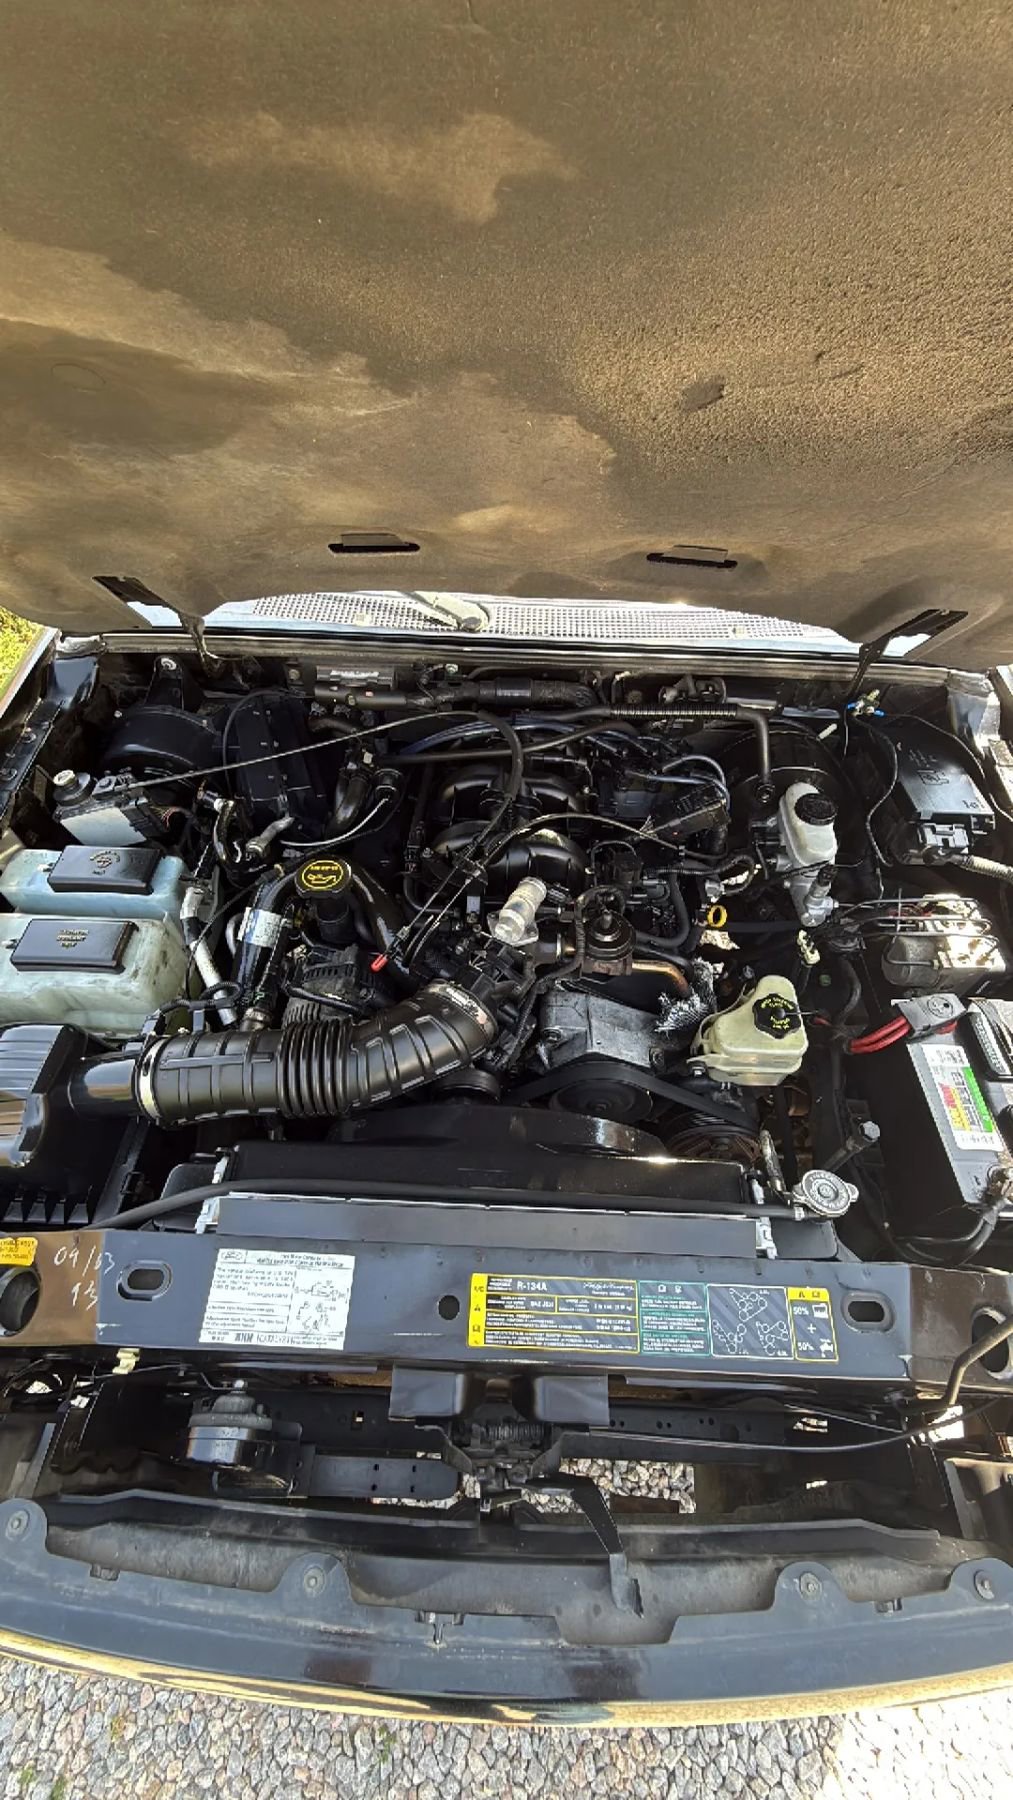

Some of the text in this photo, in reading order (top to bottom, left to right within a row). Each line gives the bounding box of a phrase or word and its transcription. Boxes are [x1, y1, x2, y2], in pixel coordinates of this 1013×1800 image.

[516, 1280, 548, 1292] R-134A
[793, 1306, 810, 1316] 50%
[797, 1342, 815, 1352] 50%
